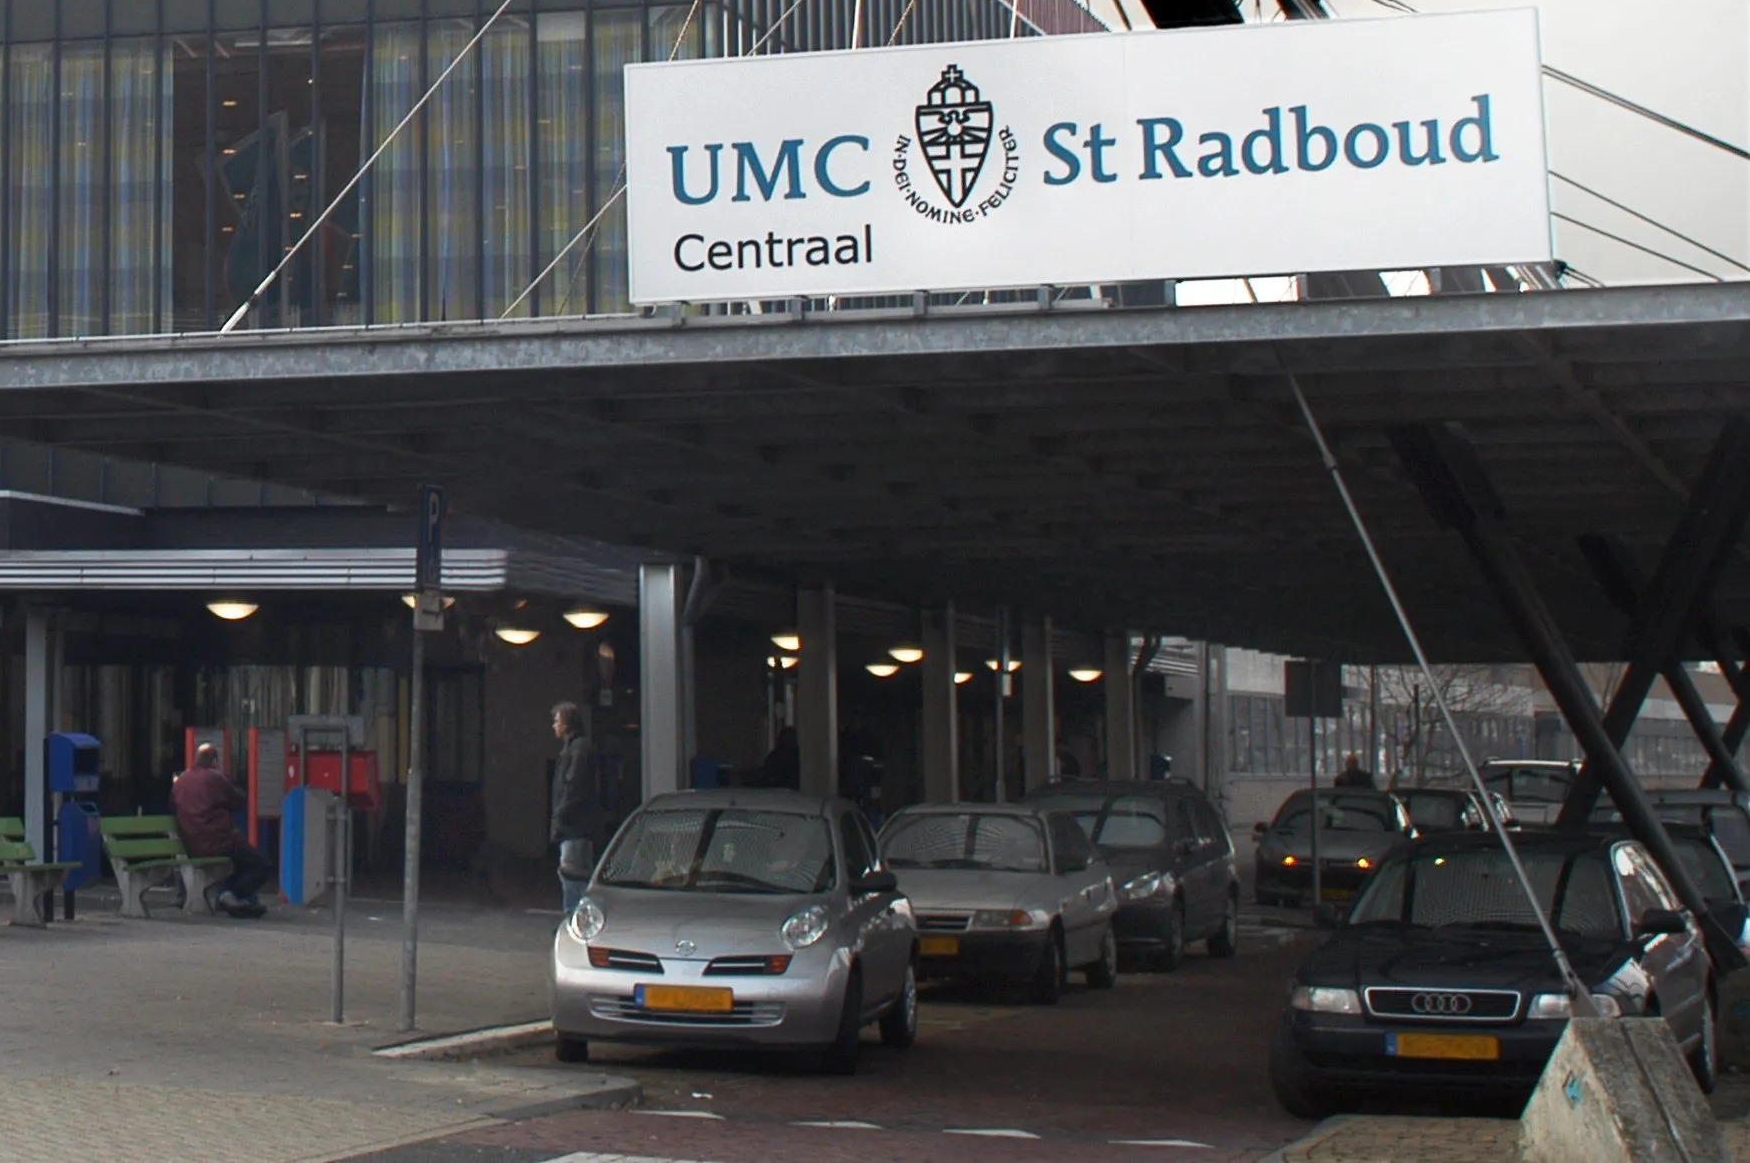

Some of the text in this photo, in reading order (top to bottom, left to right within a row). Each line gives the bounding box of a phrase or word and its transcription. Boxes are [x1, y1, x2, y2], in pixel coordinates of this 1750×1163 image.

[665, 93, 1500, 206] UMC St Radboud
[674, 223, 873, 272] Centraal
[428, 491, 440, 543] P
